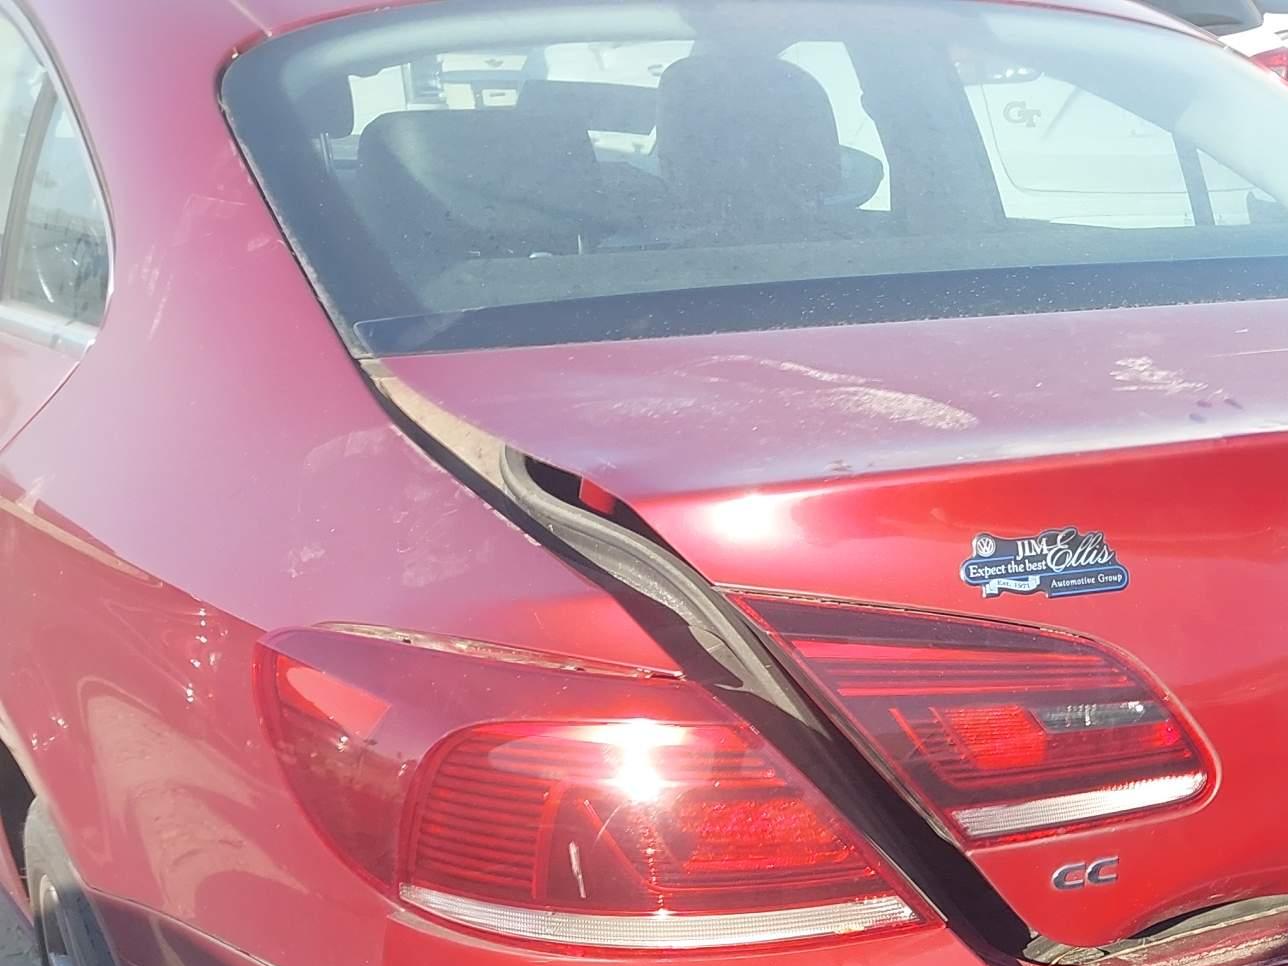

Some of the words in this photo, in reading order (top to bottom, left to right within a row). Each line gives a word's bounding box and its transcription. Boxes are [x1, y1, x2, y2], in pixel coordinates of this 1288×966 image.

[1003, 101, 1041, 127] GT
[1016, 537, 1048, 560] JIM
[1046, 528, 1114, 572] Ellis
[969, 562, 1006, 578] Expect
[1007, 559, 1025, 573] the
[1026, 558, 1048, 572] best
[1051, 575, 1096, 588] Automotive
[1097, 573, 1123, 584] Group
[1051, 856, 1119, 890] CC
